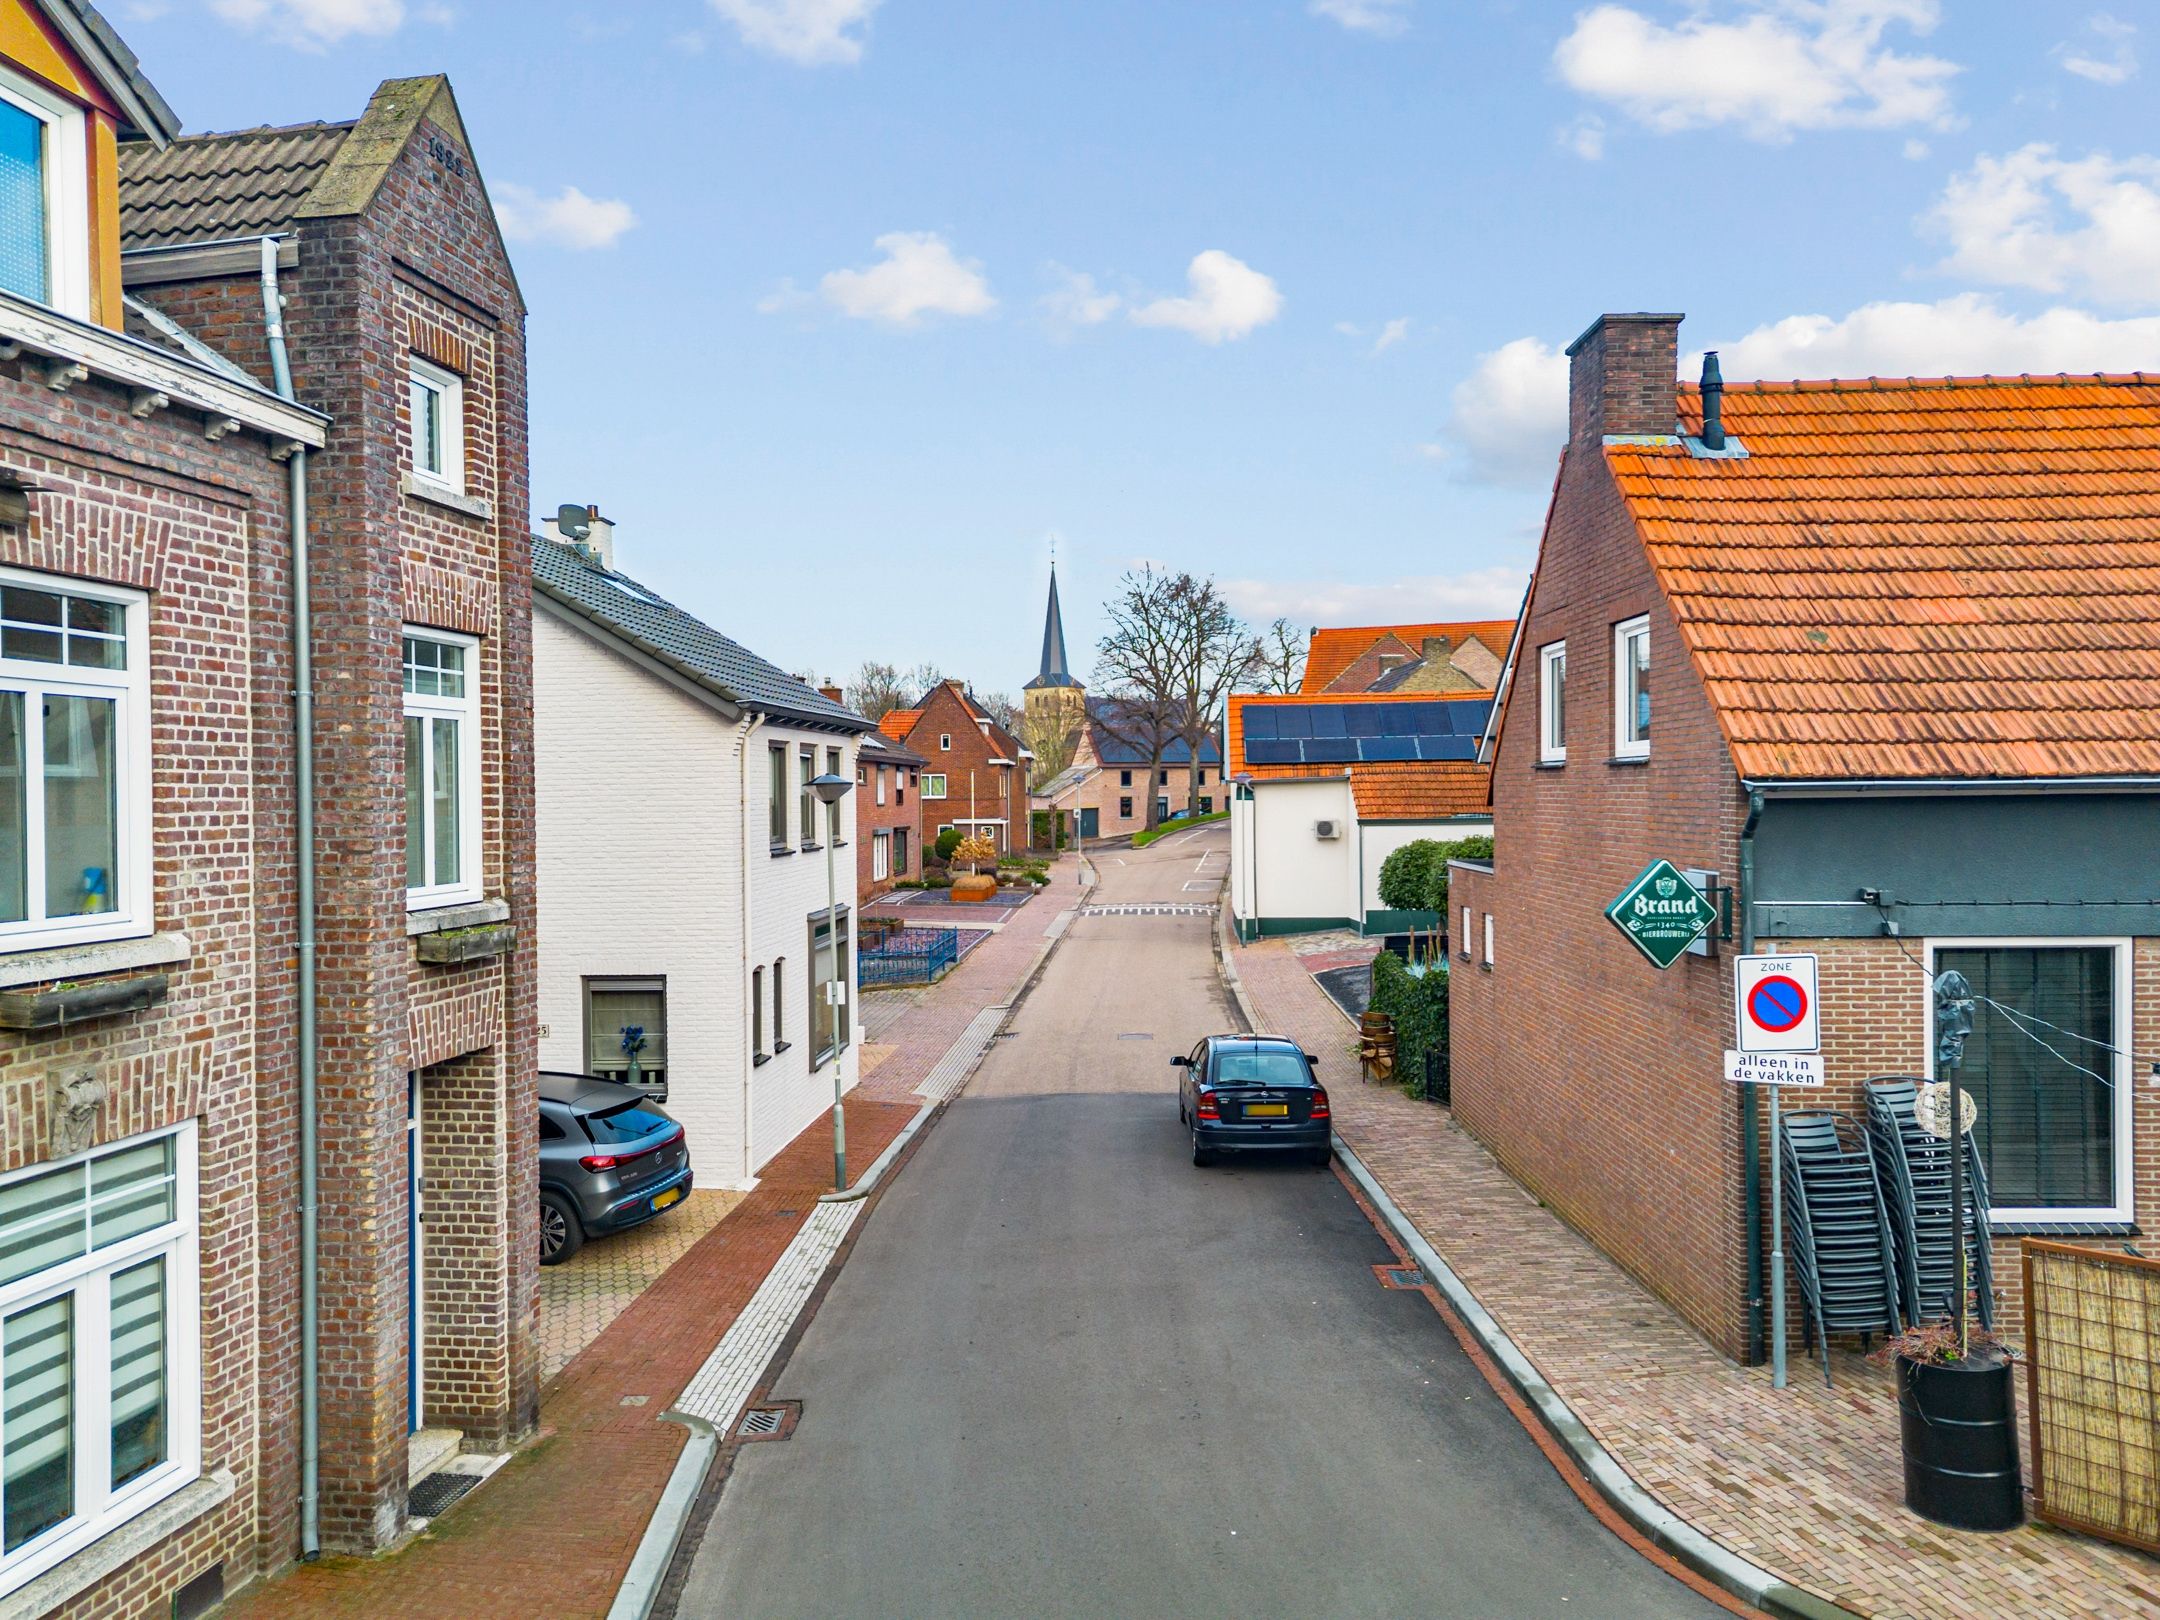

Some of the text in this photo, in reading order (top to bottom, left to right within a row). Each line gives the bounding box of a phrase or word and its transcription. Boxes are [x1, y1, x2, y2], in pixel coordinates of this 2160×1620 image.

[1634, 893, 1699, 917] Brand
[1657, 921, 1676, 929] 1340
[1642, 929, 1690, 938] BIERBROUWERIJ
[1760, 962, 1792, 972] ZONE
[1738, 1055, 1809, 1070] alleen in
[1734, 1067, 1815, 1084] de vakken
